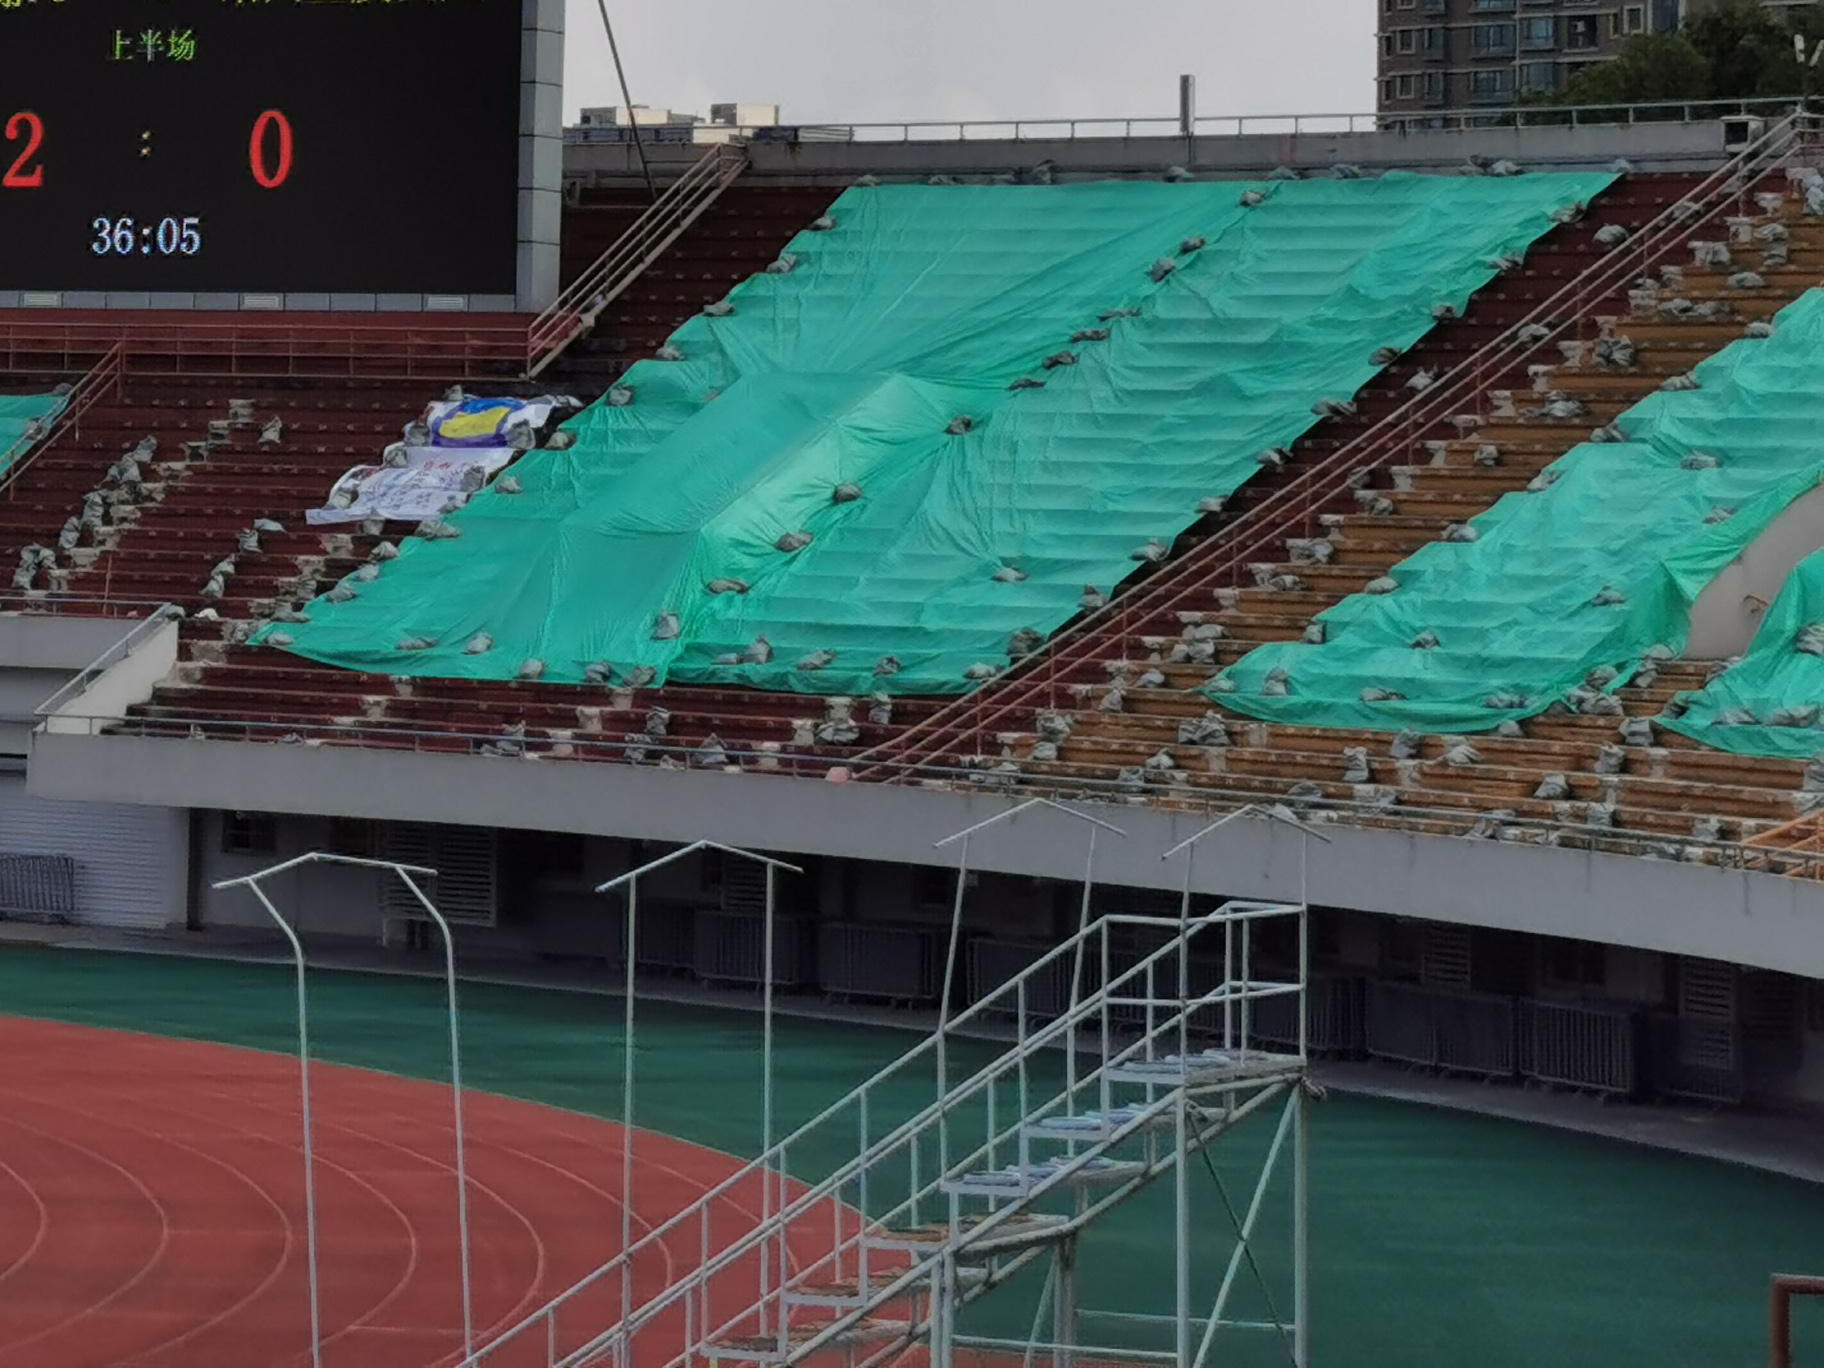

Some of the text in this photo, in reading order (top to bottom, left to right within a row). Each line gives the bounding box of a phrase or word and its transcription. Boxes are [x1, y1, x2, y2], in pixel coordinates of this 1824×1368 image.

[107, 29, 196, 62] 上半场
[2, 112, 44, 188] 2
[249, 110, 293, 189] 0
[91, 216, 201, 255] 36:05
